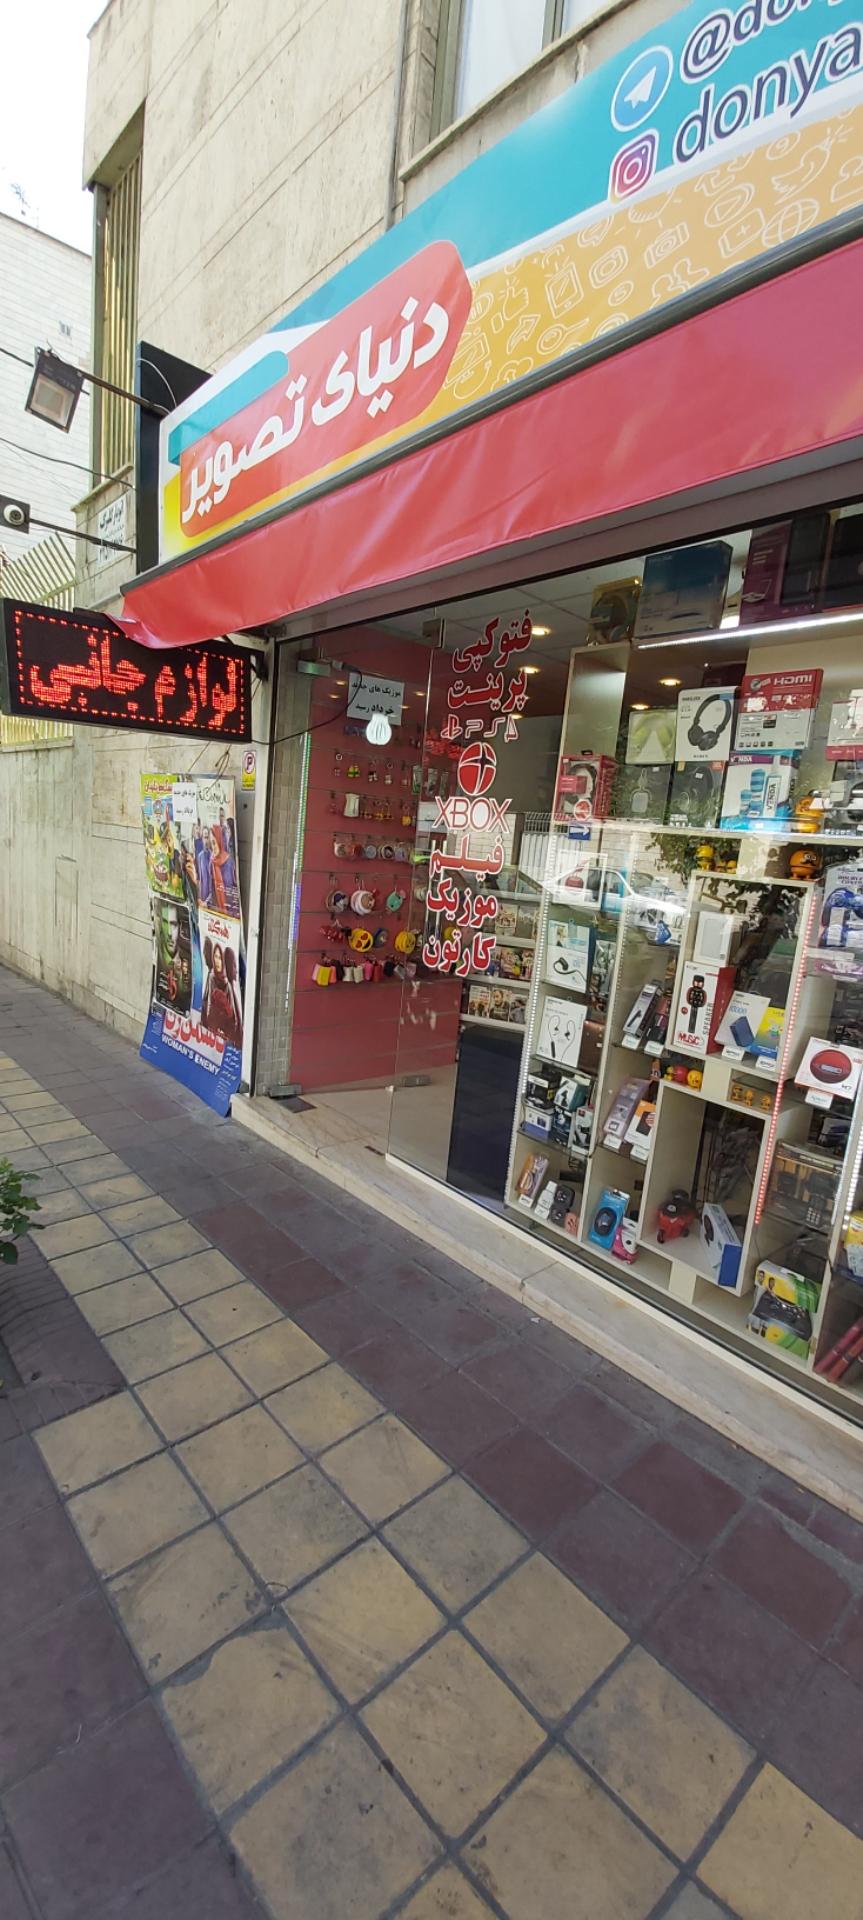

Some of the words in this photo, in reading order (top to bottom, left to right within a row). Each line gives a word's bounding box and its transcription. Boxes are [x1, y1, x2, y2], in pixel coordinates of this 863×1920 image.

[311, 296, 449, 426] دنیای
[181, 375, 308, 524] تصویر
[451, 609, 533, 673] فتوکپی
[30, 633, 146, 709] جانبی
[153, 652, 237, 728] لوازم
[446, 668, 528, 713] پرینت
[773, 674, 813, 686] HDMI
[432, 796, 513, 834] XBOX
[428, 833, 505, 883] فیلم
[425, 877, 498, 928] موزیک
[421, 931, 497, 979] کارتون
[161, 1033, 194, 1060] WOMAN'S
[194, 1053, 221, 1077] ENEMY
